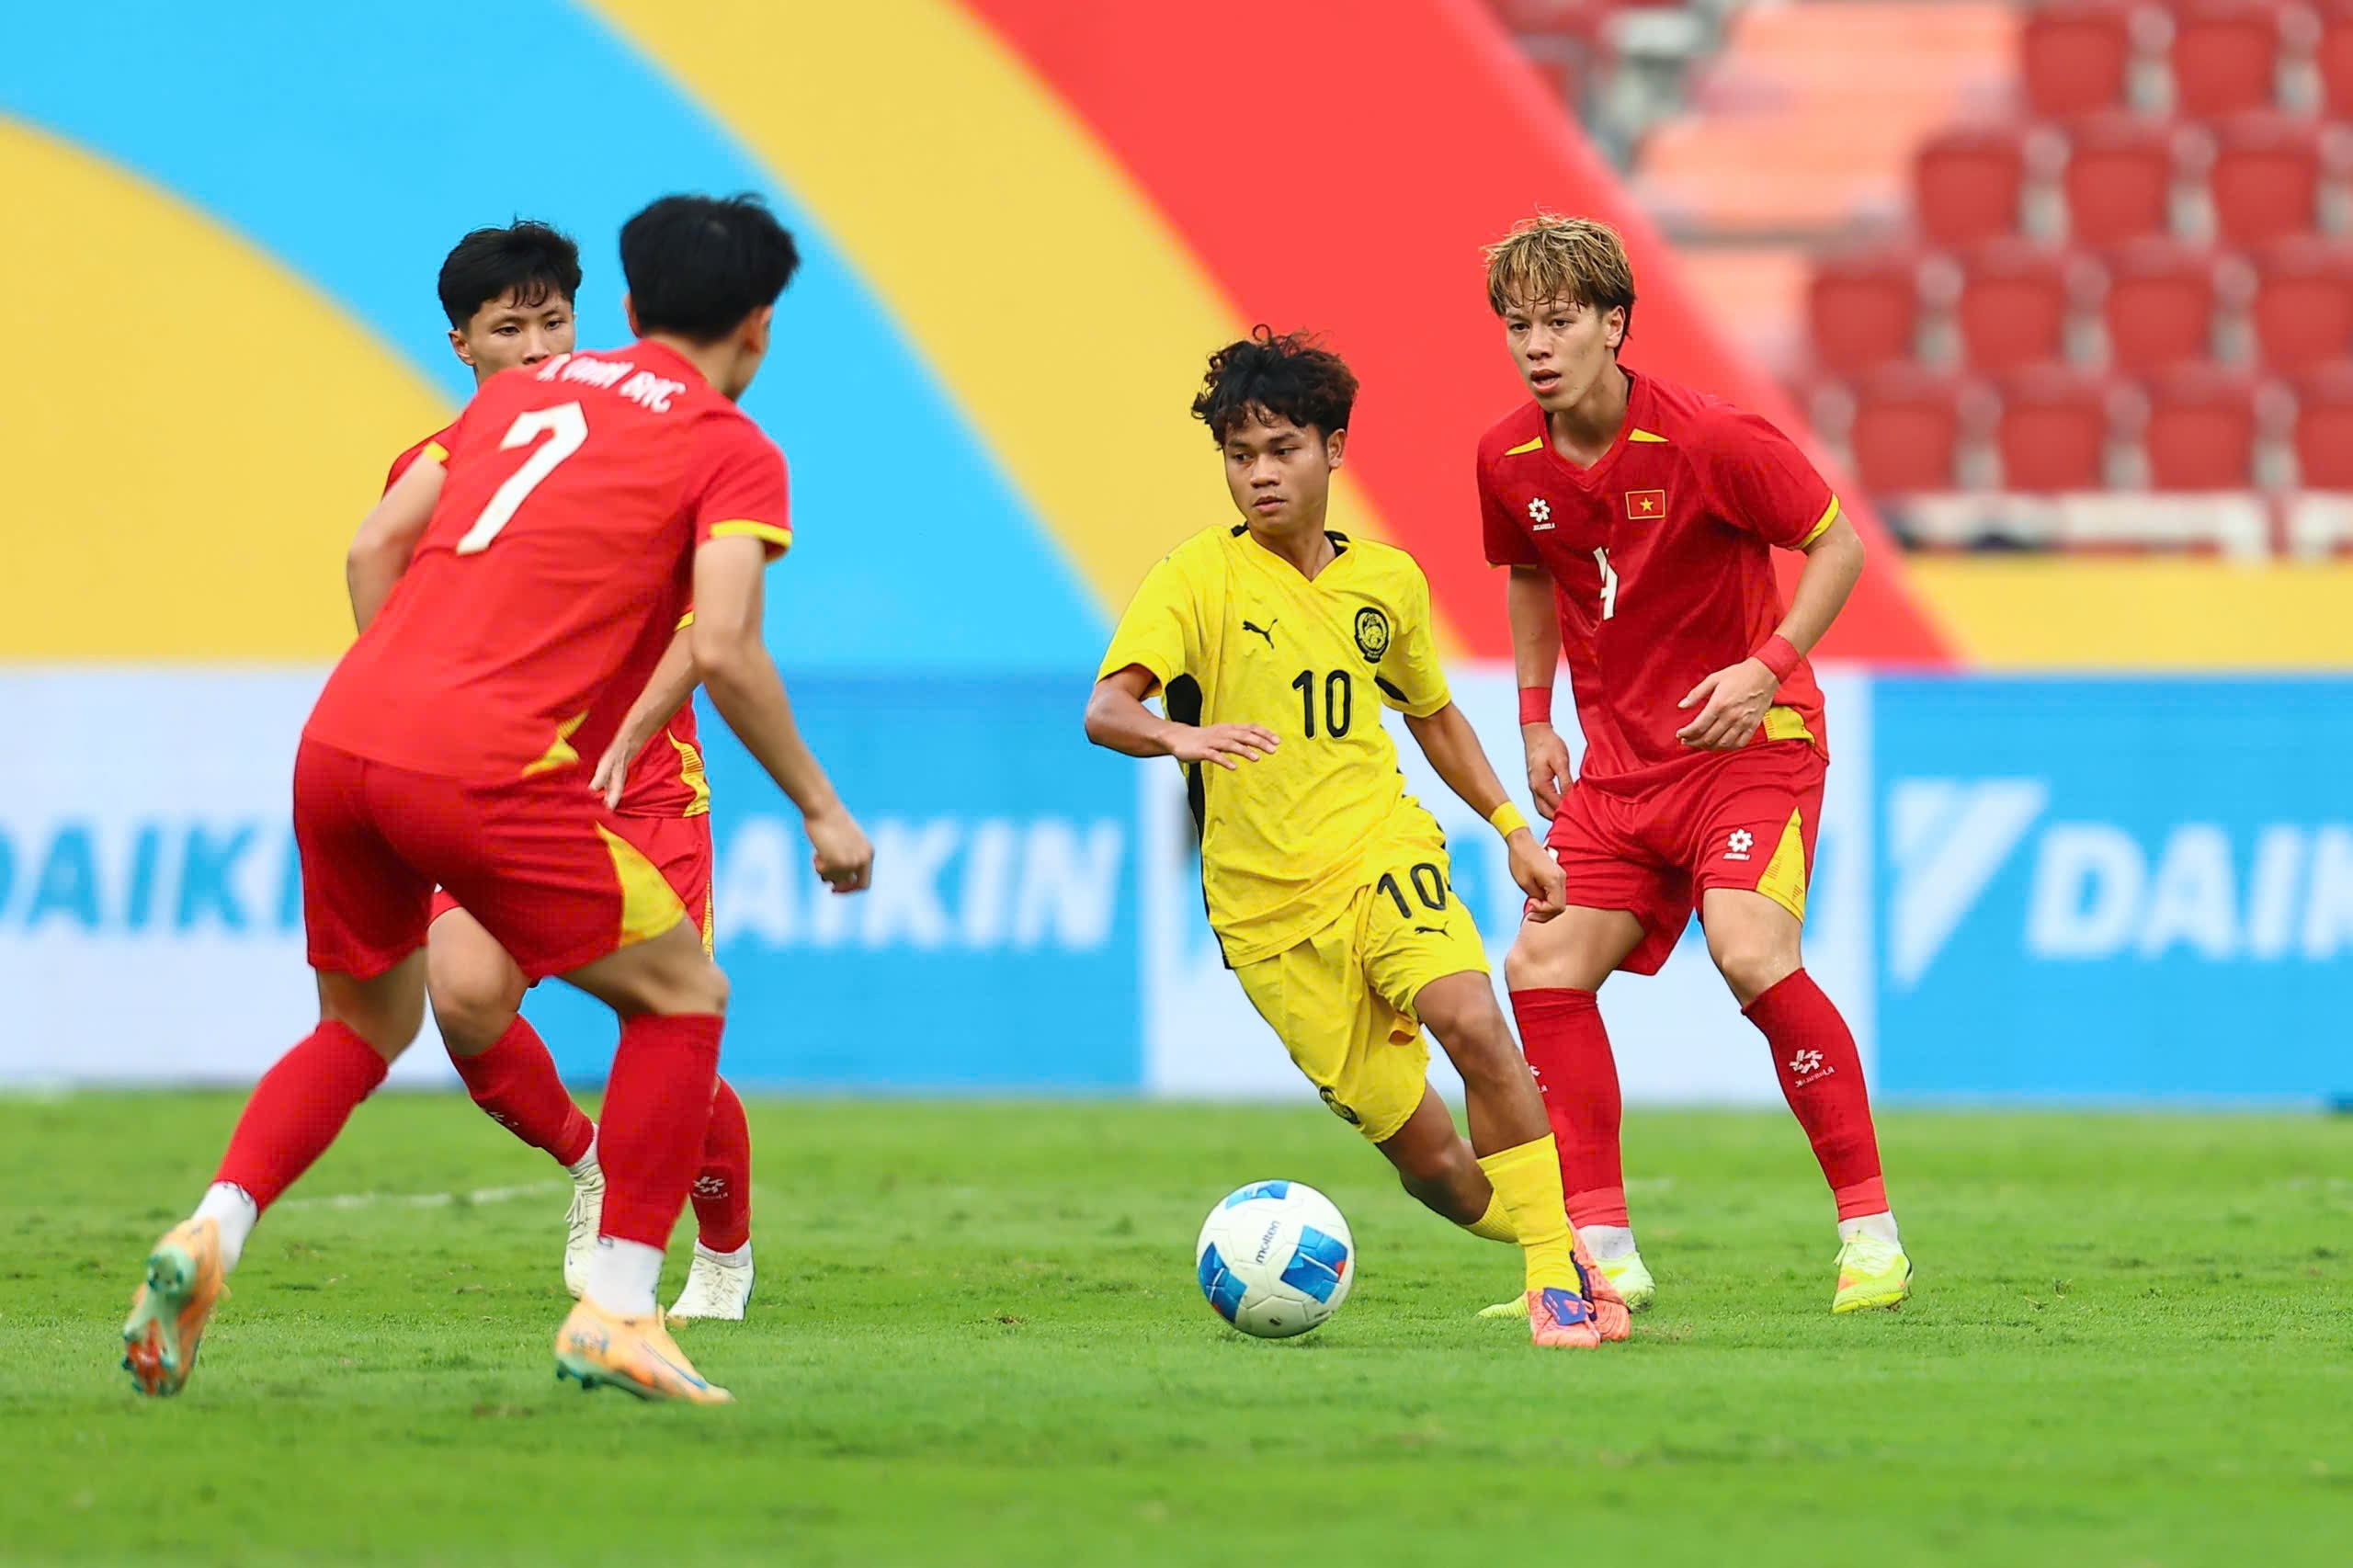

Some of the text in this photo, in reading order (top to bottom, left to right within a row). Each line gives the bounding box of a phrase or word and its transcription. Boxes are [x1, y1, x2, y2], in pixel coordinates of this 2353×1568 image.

[456, 400, 588, 555] 7
[1291, 669, 1353, 740] 10
[0, 818, 304, 931] AIKI
[1377, 862, 1447, 919] 10
[1256, 1221, 1279, 1264] molten
